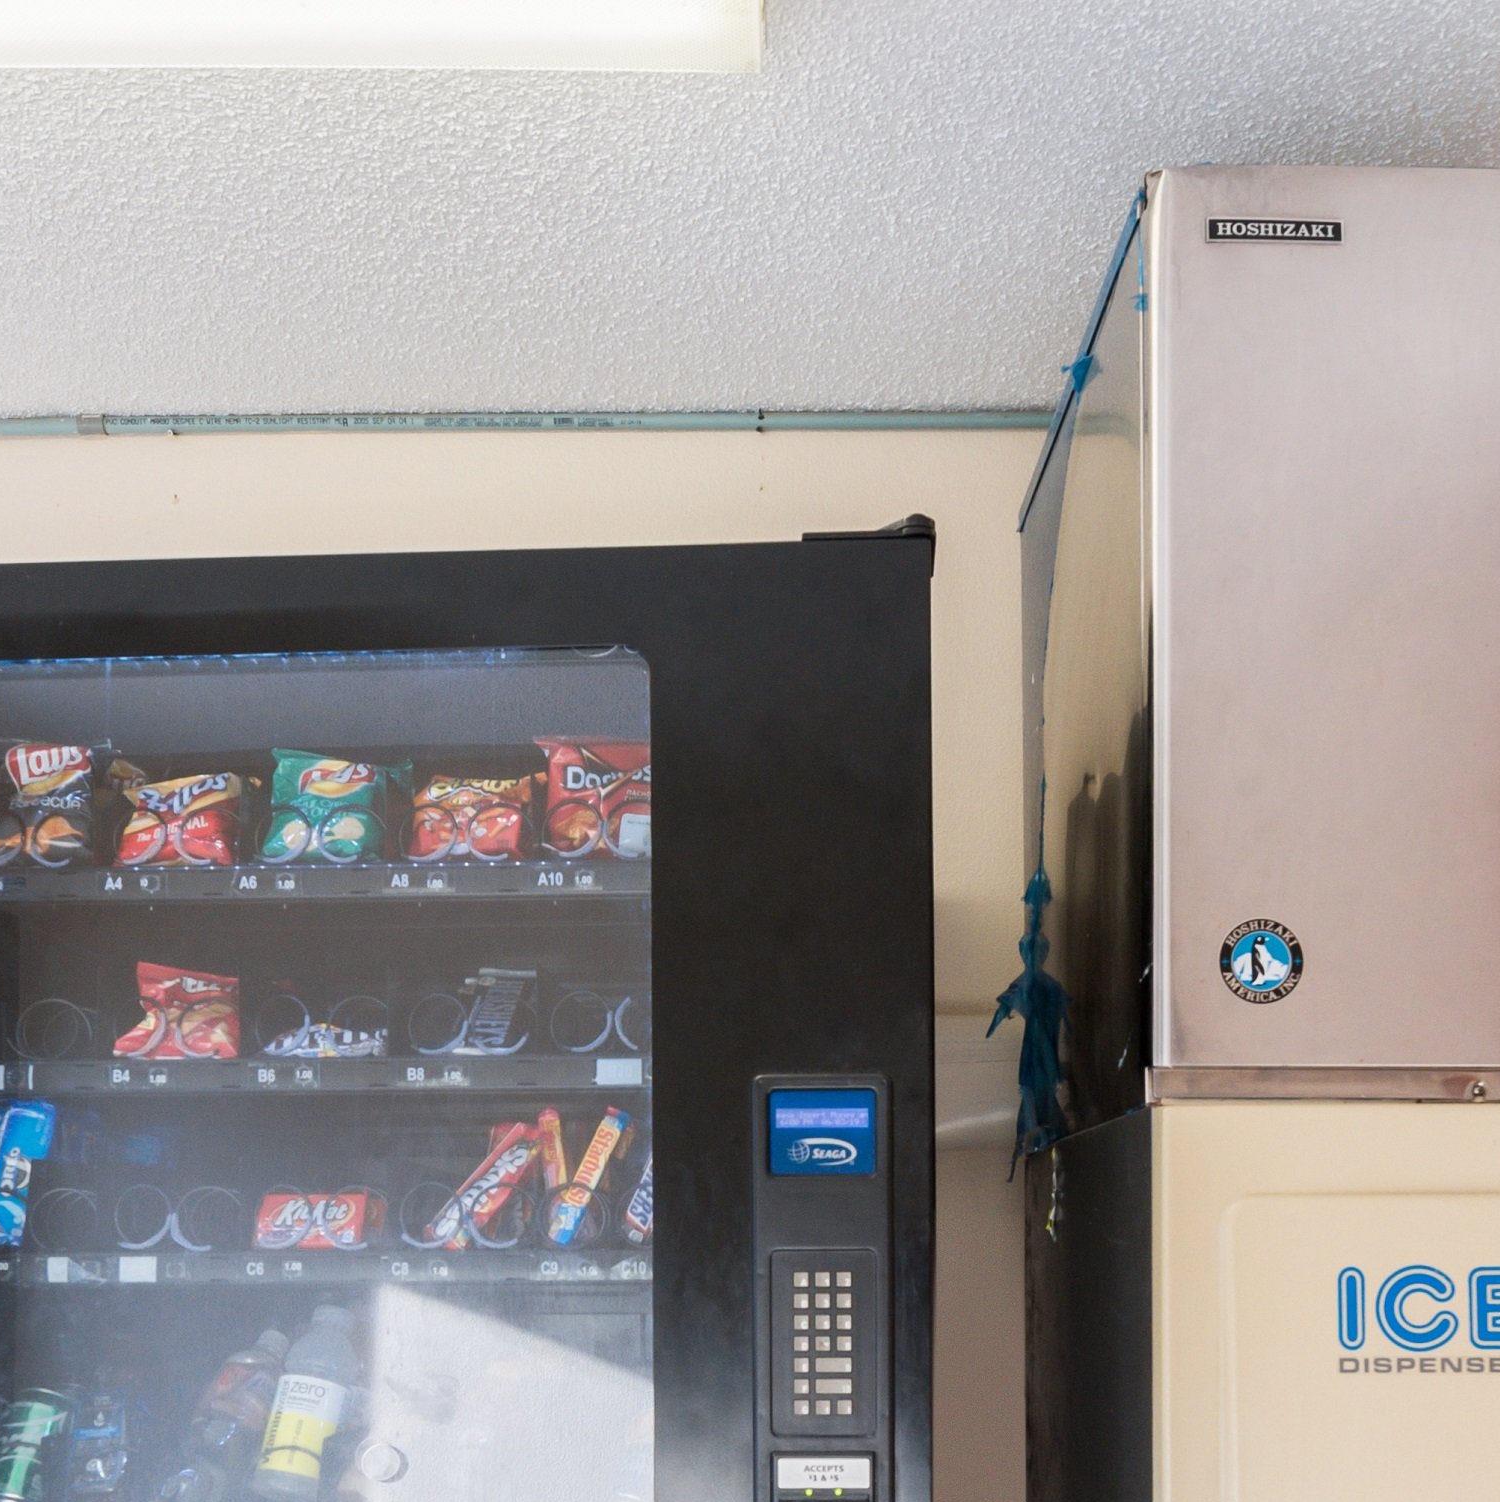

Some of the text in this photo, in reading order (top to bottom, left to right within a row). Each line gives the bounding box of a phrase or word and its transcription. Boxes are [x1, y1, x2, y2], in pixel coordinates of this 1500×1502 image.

[1216, 221, 1335, 238] HOSHIZAKI
[104, 876, 123, 891] A4
[238, 875, 295, 890] A6 1.00
[391, 873, 410, 888] A8
[537, 873, 563, 887] A10
[1224, 920, 1298, 947] HOSHIZAKI
[112, 1069, 130, 1083] B4
[257, 1069, 276, 1083] B6
[406, 1067, 424, 1081] B8
[811, 1148, 846, 1160] SEAGA
[246, 1262, 264, 1276] C6
[391, 1262, 409, 1276] C8
[540, 1261, 559, 1275] C9
[622, 1261, 647, 1275] C10
[290, 1381, 326, 1398] zero
[803, 1465, 844, 1473] ACCEPTS
